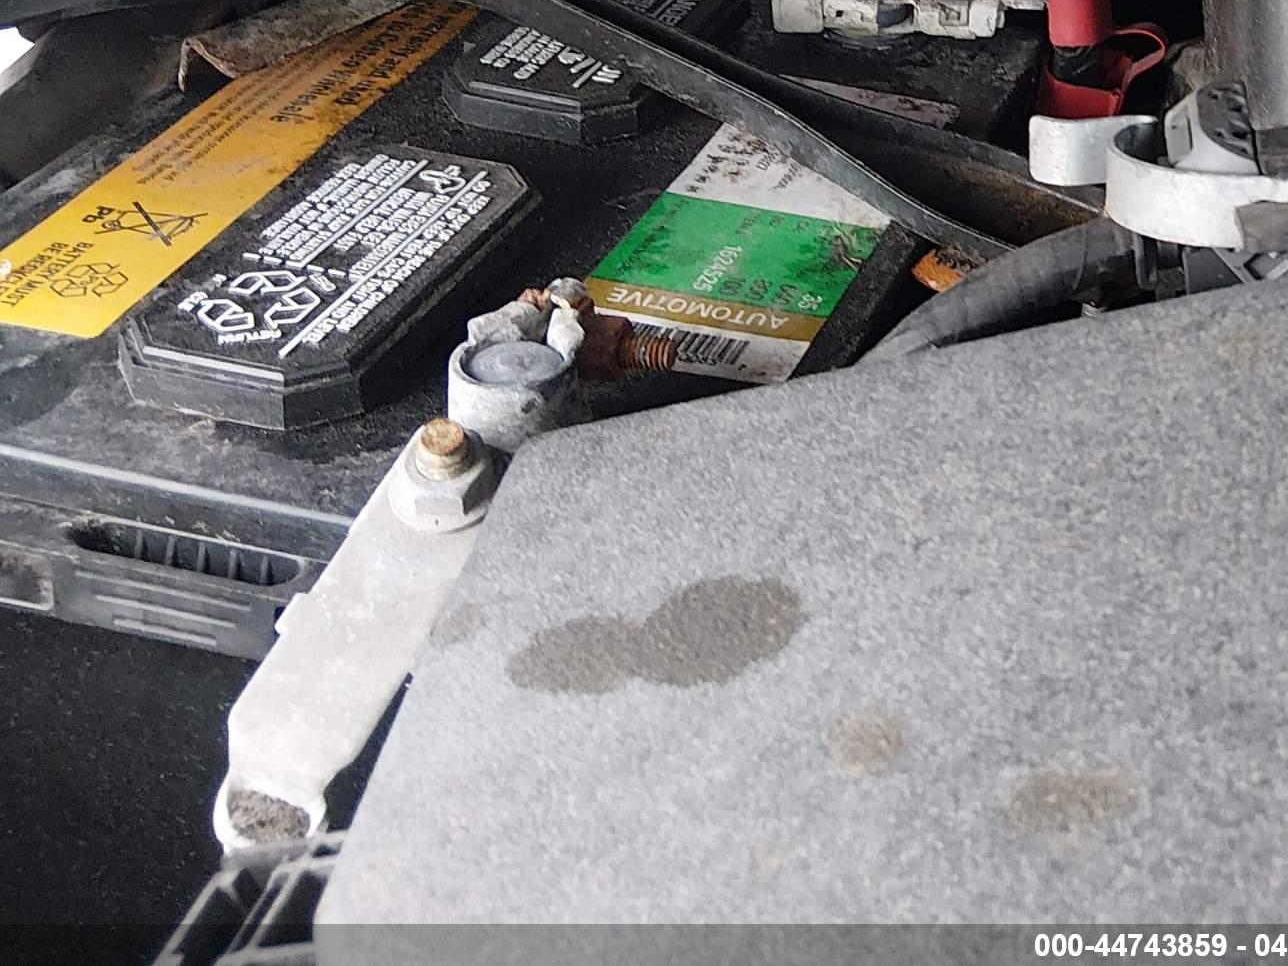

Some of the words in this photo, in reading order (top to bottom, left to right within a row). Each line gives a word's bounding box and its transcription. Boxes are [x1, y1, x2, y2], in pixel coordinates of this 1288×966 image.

[371, 54, 400, 79] and
[81, 206, 114, 224] Pb
[42, 242, 68, 255] BE
[37, 242, 94, 281] BATTERY
[1, 279, 43, 307] MUST
[330, 300, 355, 319] AND
[606, 286, 789, 330] AUTOMOTIVE
